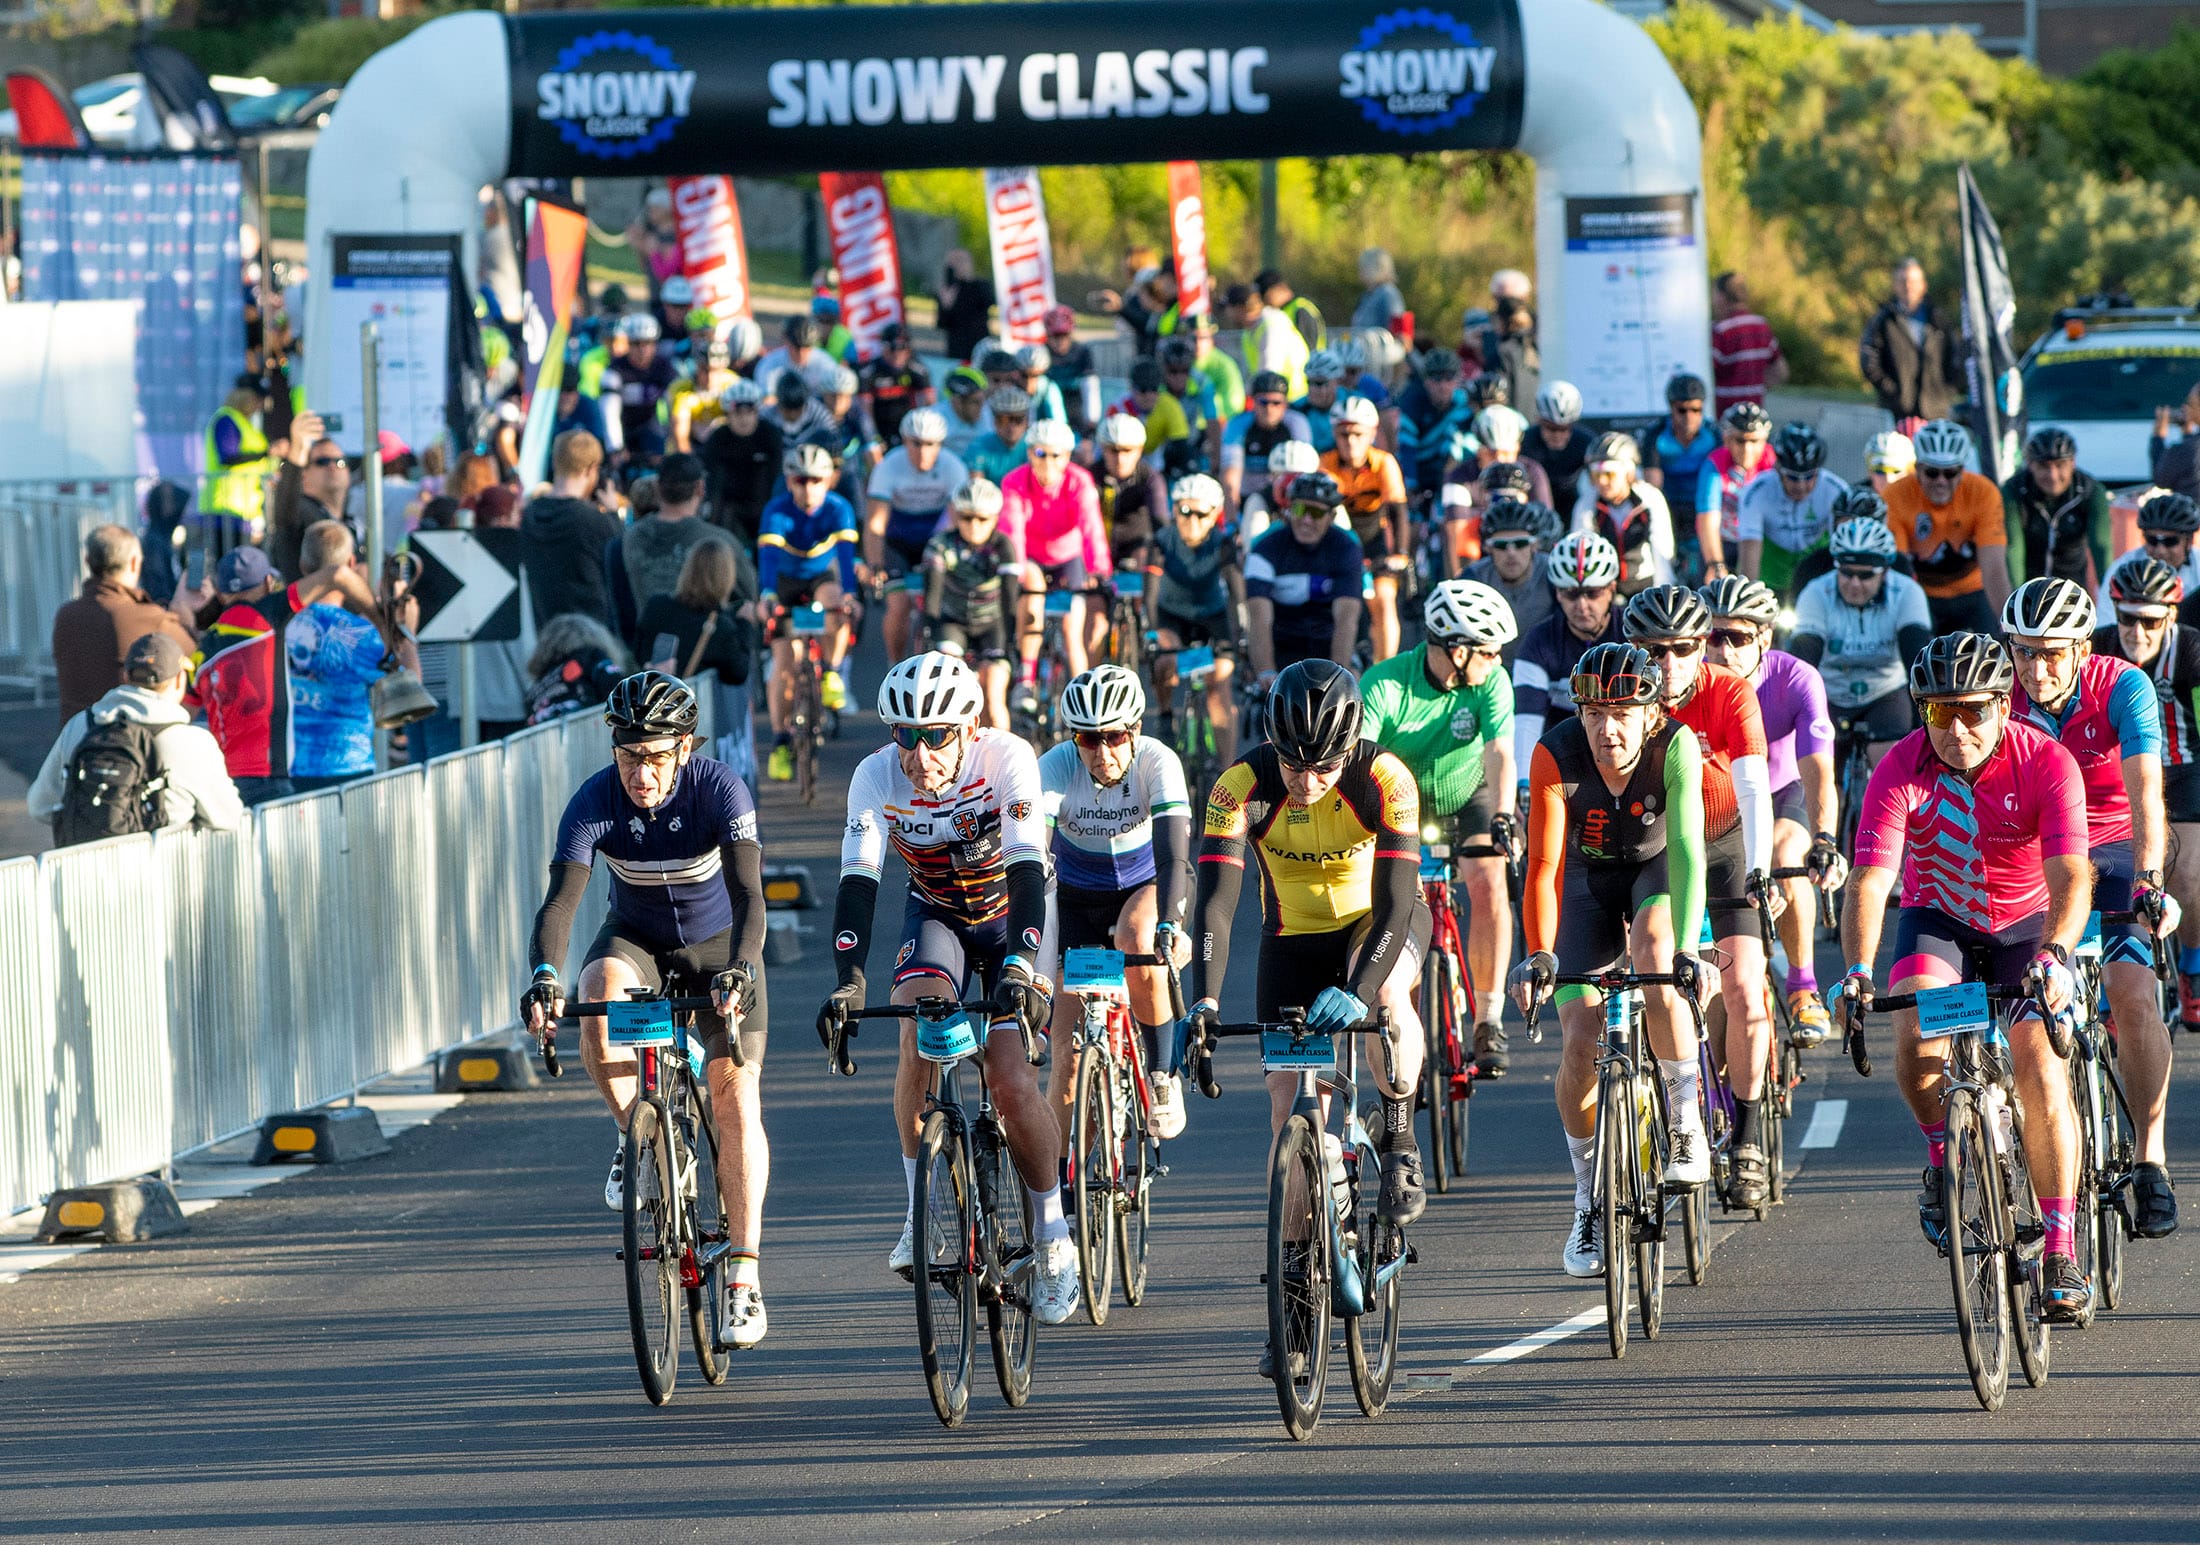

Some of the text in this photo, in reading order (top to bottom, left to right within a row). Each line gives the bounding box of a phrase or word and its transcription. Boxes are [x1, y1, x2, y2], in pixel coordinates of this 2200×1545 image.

[1338, 46, 1498, 98] SNOWY
[537, 70, 698, 120] SNOWY
[767, 46, 1270, 128] SNOWY CLASSIC
[1387, 94, 1450, 114] CLASSIC
[585, 117, 649, 137] CLASSIC
[675, 174, 744, 320] CLING
[729, 810, 757, 831] SYDNE
[1075, 805, 1140, 821] Jindabyne
[901, 822, 934, 836] UCI
[1068, 821, 1117, 838] Cycling
[963, 843, 992, 857] CYCLING
[970, 838, 990, 850] KILDA
[965, 852, 985, 863] CLUB
[1203, 932, 1214, 961] FUSION
[1370, 930, 1394, 963] FUSION
[1943, 1001, 1965, 1011] 110KM
[1924, 1008, 1985, 1024] CHALLENGE CLASSIC
[611, 1025, 669, 1034] CHALLENGE CLASSIC
[948, 1035, 972, 1049] CLASSIC
[1269, 1049, 1331, 1057] CHALLENGE CLASSIC
[1397, 1101, 1408, 1133] FUSION
